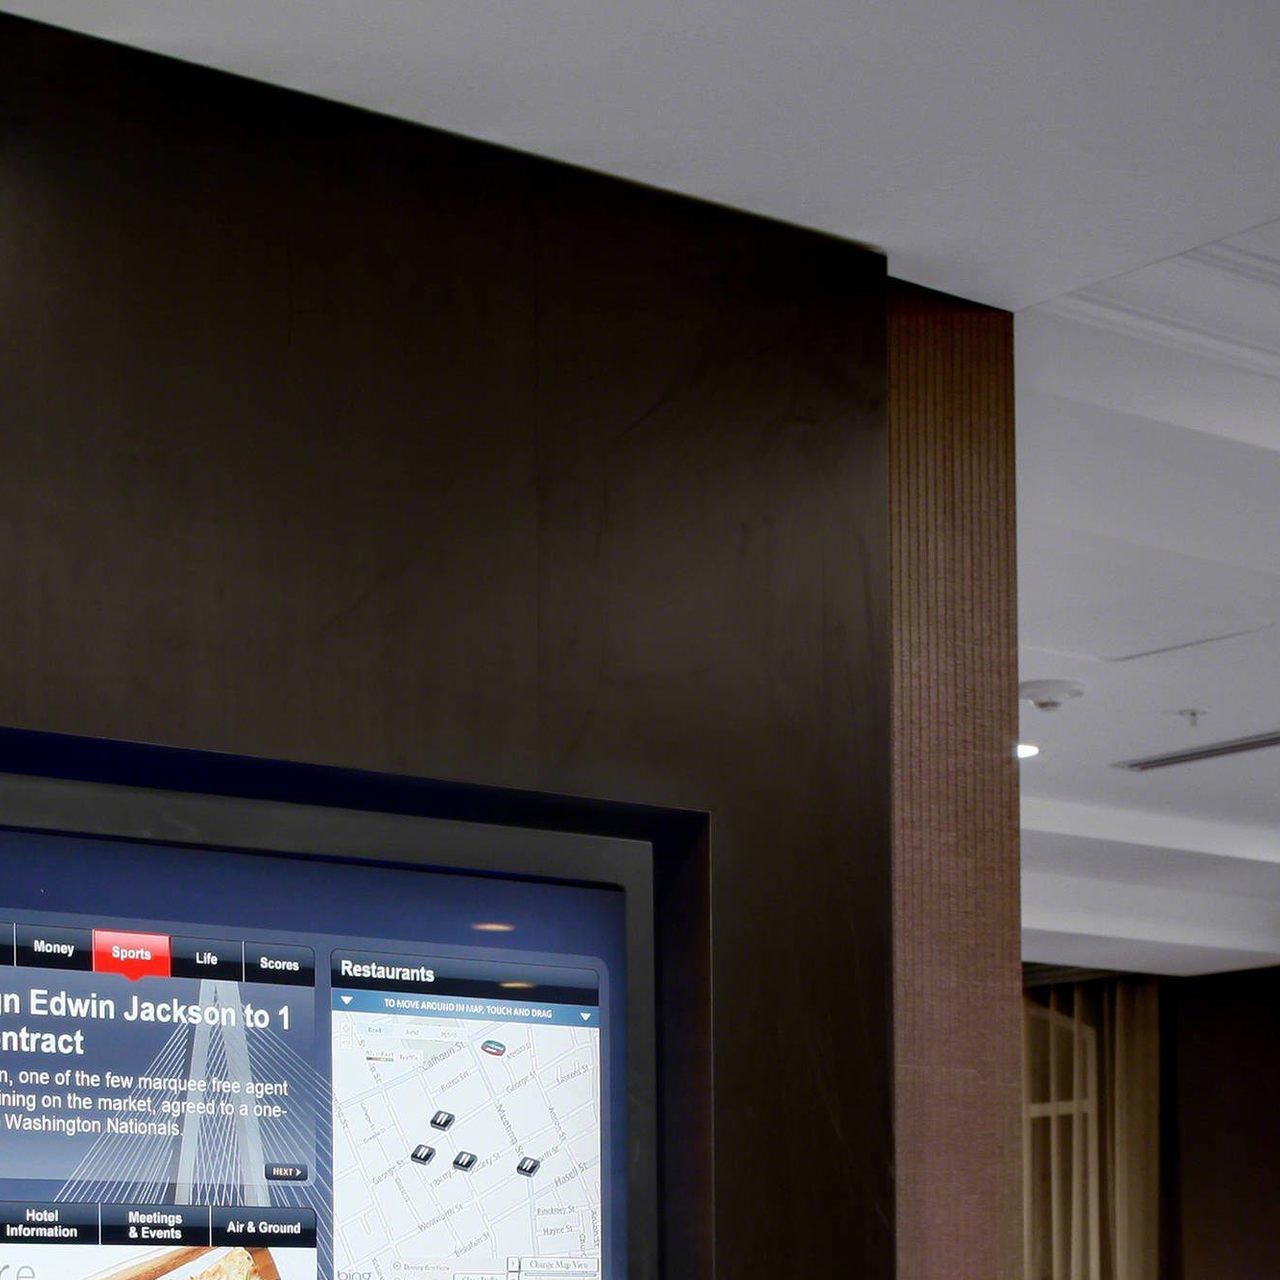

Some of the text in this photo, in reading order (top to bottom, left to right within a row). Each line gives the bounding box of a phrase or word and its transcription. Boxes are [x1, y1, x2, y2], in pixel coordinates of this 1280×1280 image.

[34, 939, 75, 958] Money
[112, 945, 151, 961] Sports
[196, 952, 218, 965] Life
[260, 956, 300, 972] Scores
[341, 960, 435, 982] Restaurants
[30, 989, 115, 1020] Edwin
[123, 995, 236, 1026] Jackson
[244, 1005, 270, 1030] to
[278, 1006, 290, 1030] 1
[384, 998, 395, 1008] TO
[396, 999, 419, 1010] MOVE
[421, 1000, 454, 1012] AROUND
[456, 1002, 465, 1012] IN
[486, 1005, 512, 1016] TOUCH
[513, 1006, 530, 1017] AND
[532, 1008, 552, 1018] DRAG
[19, 1071, 50, 1085] one
[55, 1070, 72, 1086] of
[75, 1071, 101, 1087] the
[105, 1072, 133, 1088] few
[138, 1076, 207, 1093] marquee
[212, 1077, 241, 1093] free
[245, 1080, 288, 1097] agent
[41, 1095, 62, 1109] on
[67, 1093, 93, 1110] the
[98, 1096, 156, 1115] market,
[161, 1099, 215, 1117] agreed
[219, 1102, 235, 1116] to
[239, 1106, 249, 1116] a
[253, 1106, 287, 1117] one-
[5, 1113, 101, 1136] Washington
[106, 1118, 183, 1136] Nationals.
[272, 1168, 293, 1176] NEXT
[26, 1209, 59, 1222] Hotel
[128, 1211, 183, 1225] Meetings
[6, 1224, 78, 1238] Information
[128, 1227, 182, 1240] & Events
[227, 1221, 301, 1235] Air & Ground
